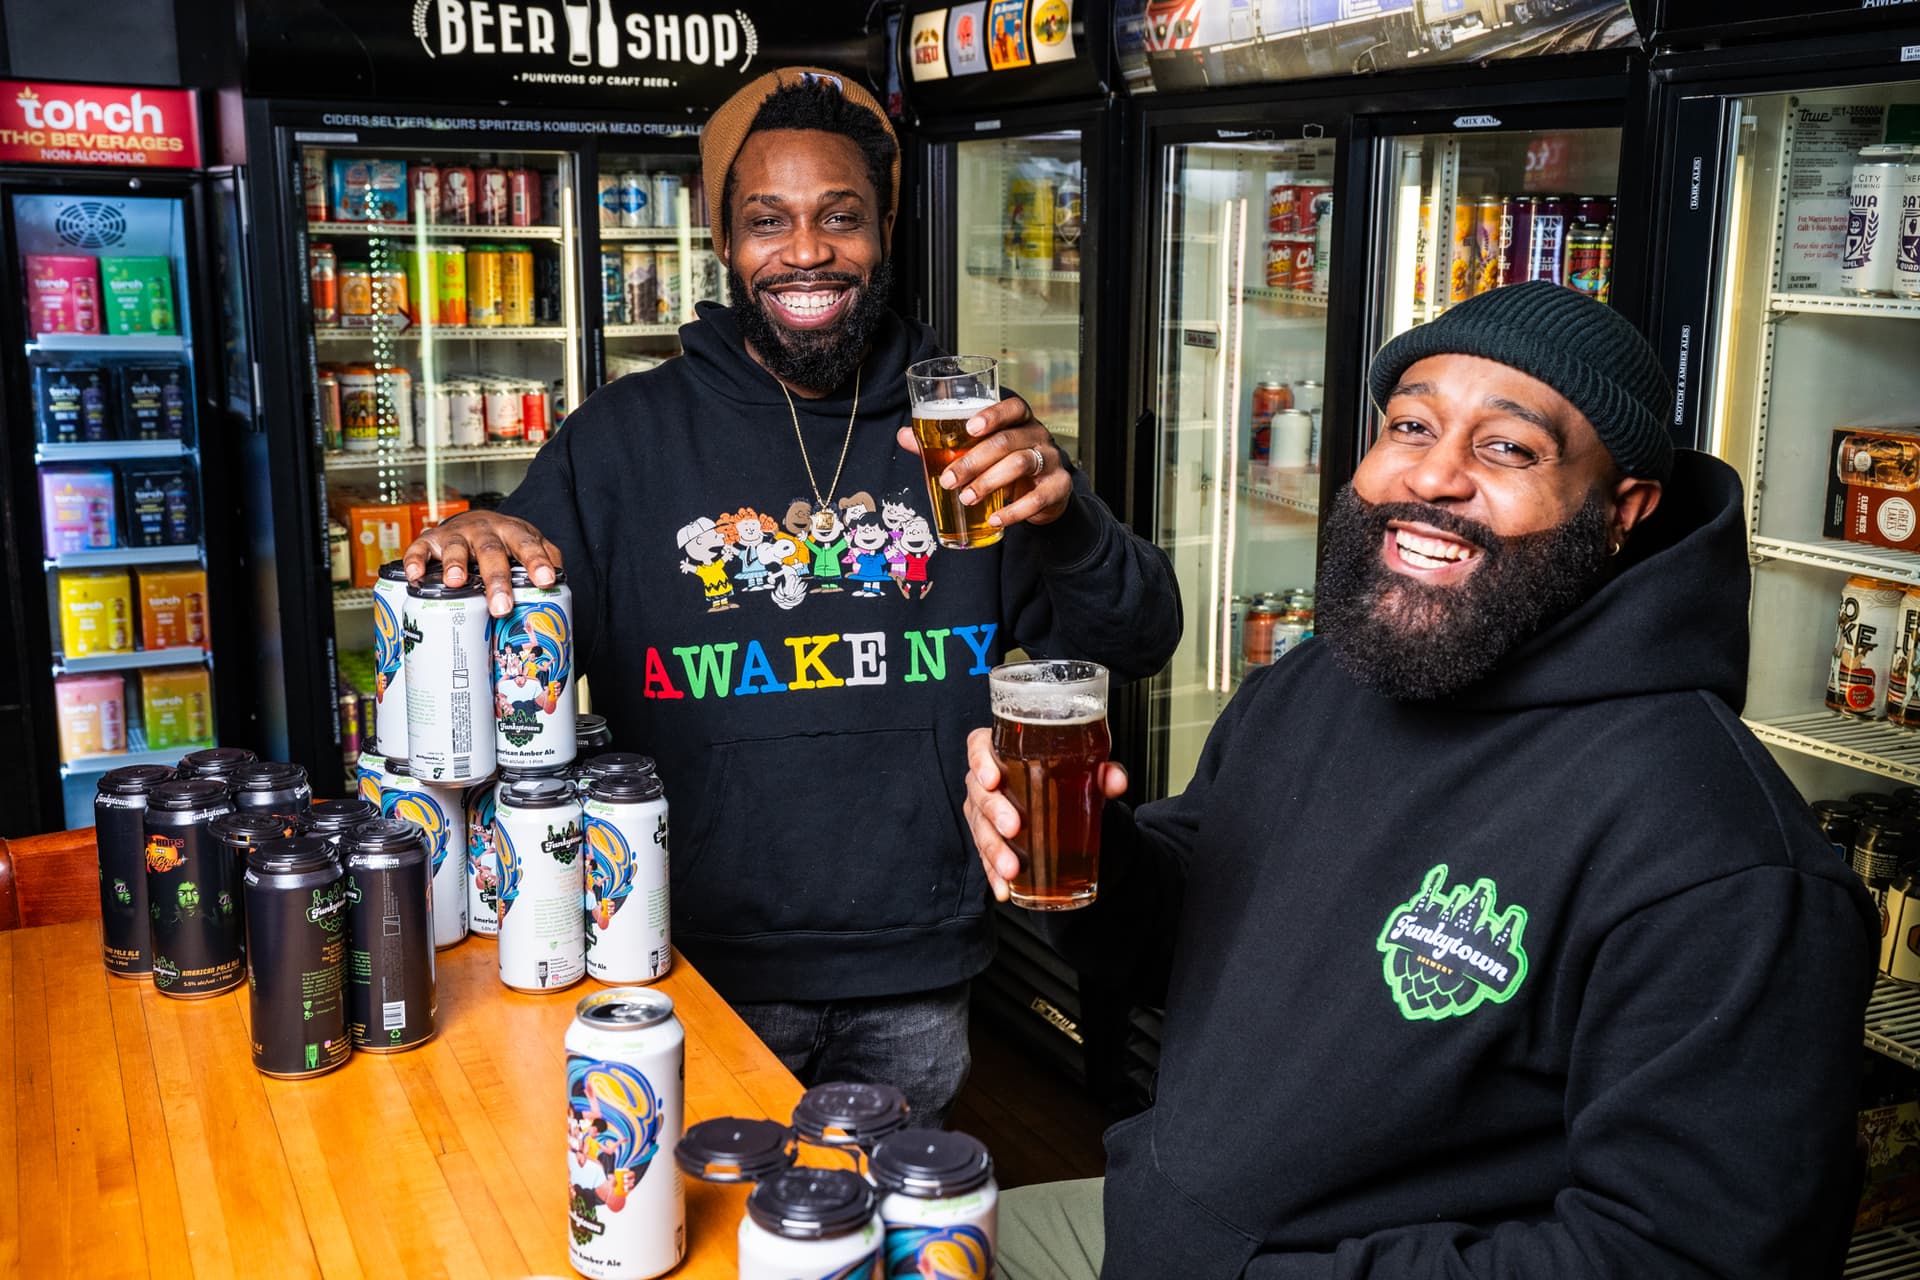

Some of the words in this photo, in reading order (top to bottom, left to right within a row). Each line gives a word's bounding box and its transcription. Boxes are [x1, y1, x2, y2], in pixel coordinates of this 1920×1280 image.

[438, 0, 555, 54] BEER
[625, 13, 739, 66] SHOP
[522, 73, 585, 84] PURVEYORS
[588, 75, 604, 85] OF
[606, 76, 641, 86] CRAFT
[643, 78, 670, 87] BEER
[16, 92, 163, 134] torch
[322, 114, 369, 126] CIDERS
[371, 115, 433, 128] SELTZERS
[435, 117, 477, 129] SOURS
[479, 119, 541, 131] SPRITZERS
[543, 121, 608, 134] KOMBUCHA
[609, 122, 640, 134] MEAD
[643, 124, 682, 136] CREAM
[0, 129, 46, 145] THC
[51, 133, 184, 152] BEVERAGES
[1691, 183, 1699, 206] DARK
[644, 632, 887, 699] AWAKE
[904, 623, 998, 683] NY
[500, 723, 540, 733] Funkytown
[519, 749, 543, 757] Amber
[545, 748, 555, 756] Ale
[474, 916, 498, 924] America
[1390, 915, 1509, 983] Funkytown
[1416, 955, 1454, 975] BREWERY
[607, 1259, 621, 1267] Ale
